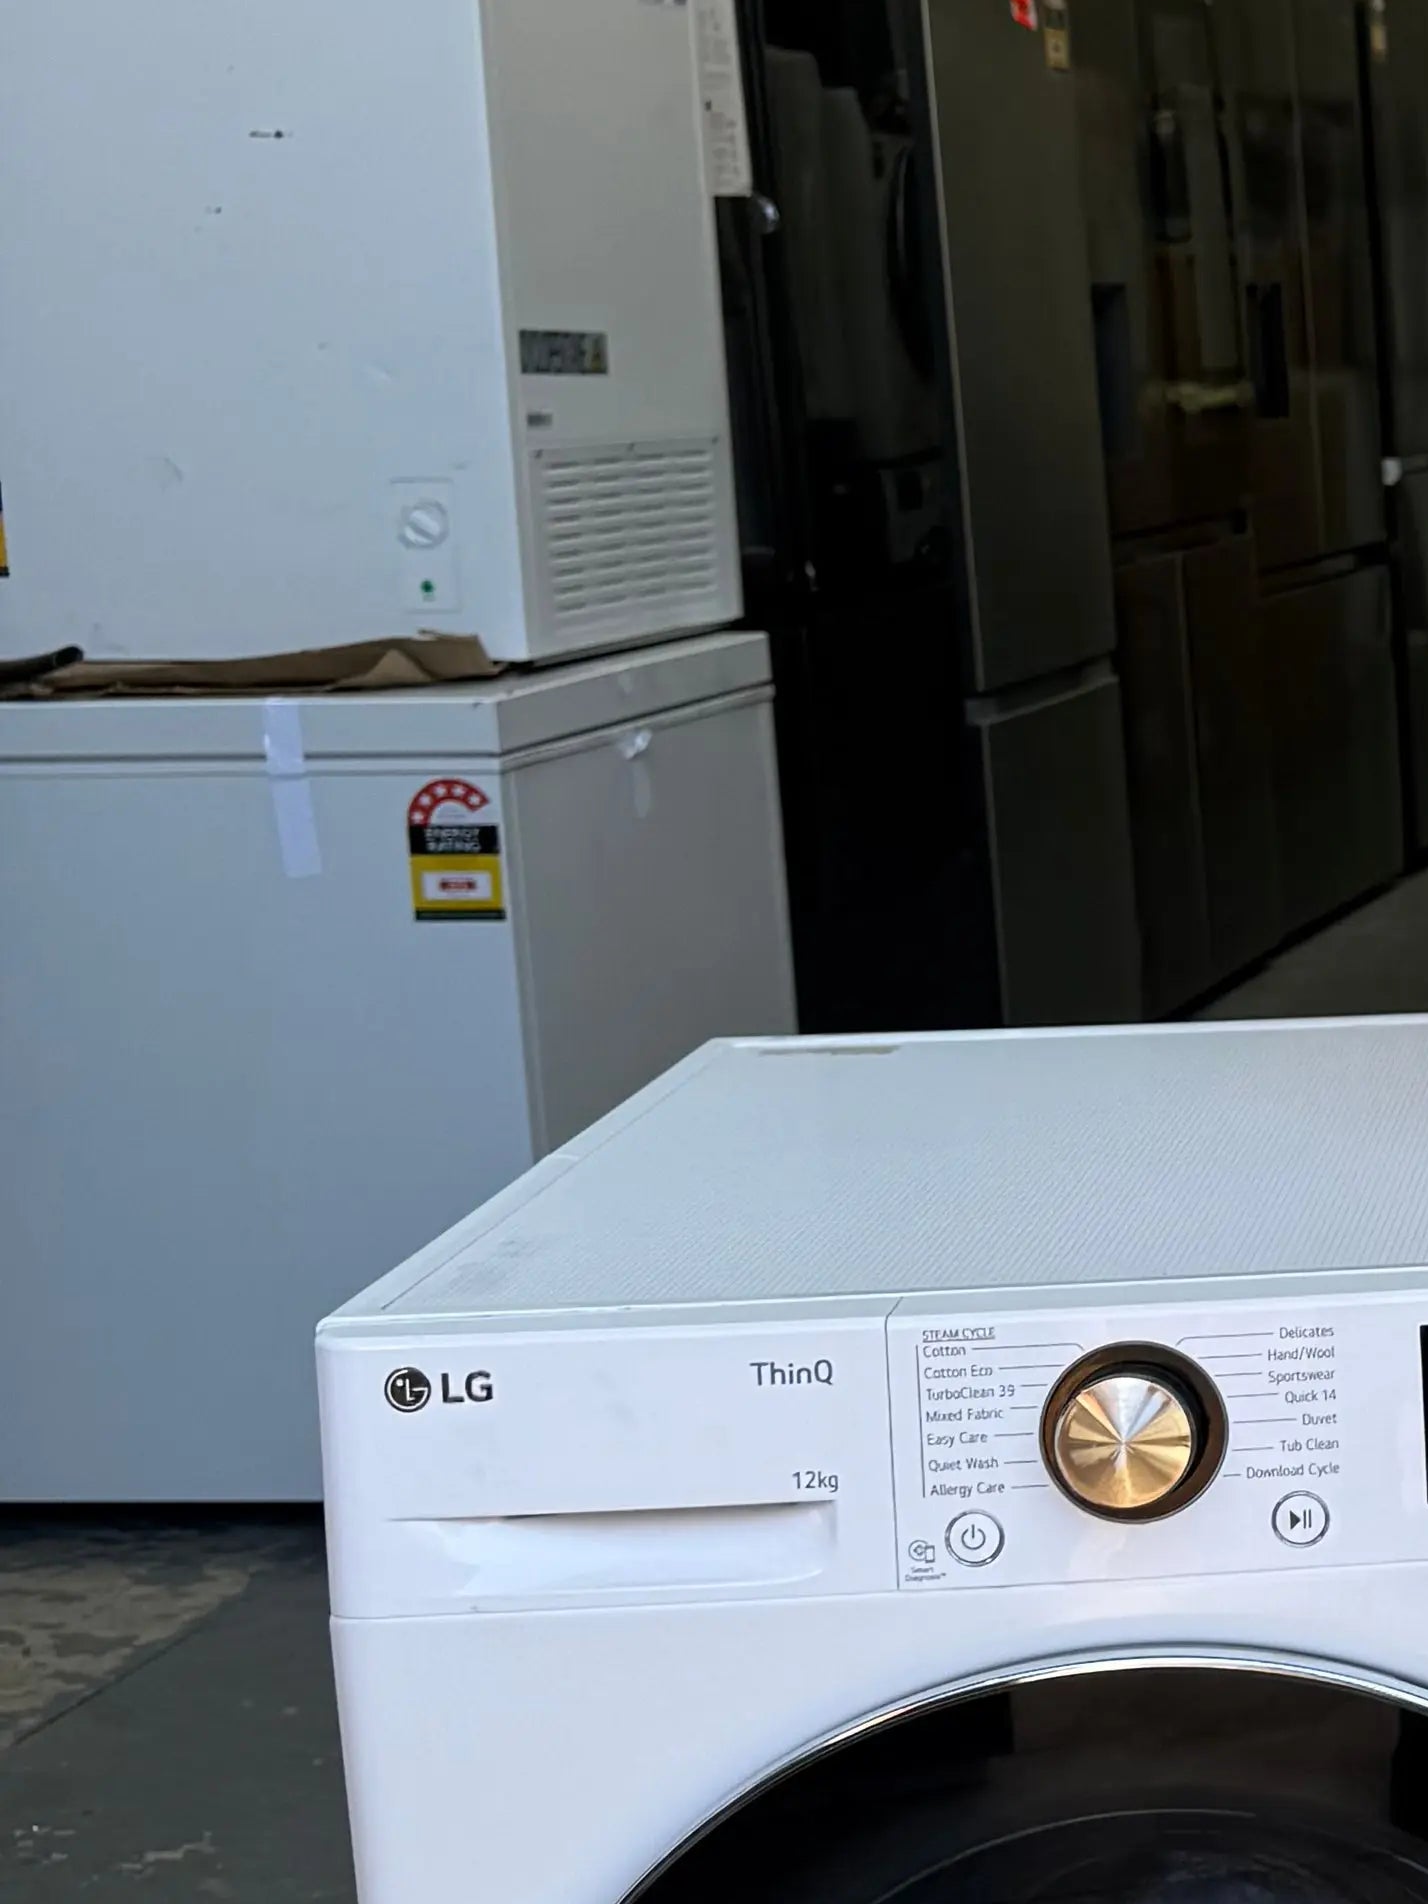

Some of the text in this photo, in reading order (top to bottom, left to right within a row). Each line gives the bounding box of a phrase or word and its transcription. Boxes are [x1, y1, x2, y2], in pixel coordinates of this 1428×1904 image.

[922, 1327, 995, 1341] STEAM CYCLE
[1279, 1326, 1335, 1339] Delicates
[922, 1345, 966, 1358] Cotton
[1267, 1345, 1335, 1361] Hand/Wool
[749, 1359, 833, 1386] ThinQ
[924, 1364, 993, 1379] Cotton Eco
[1268, 1369, 1336, 1386] Sportswear
[440, 1370, 493, 1403] LG
[926, 1387, 995, 1401] TurboClean
[1284, 1388, 1337, 1404] Quick 14
[926, 1408, 1004, 1423] Mixed Fabric
[1302, 1413, 1337, 1426] Duvet
[927, 1431, 988, 1448] Easy Care
[1280, 1438, 1339, 1452] Tub Clean
[928, 1457, 999, 1472] Quiet Wash
[1246, 1462, 1340, 1479] Download Cycle
[792, 1470, 839, 1493] 12kg
[930, 1481, 1005, 1498] Allergy Care
